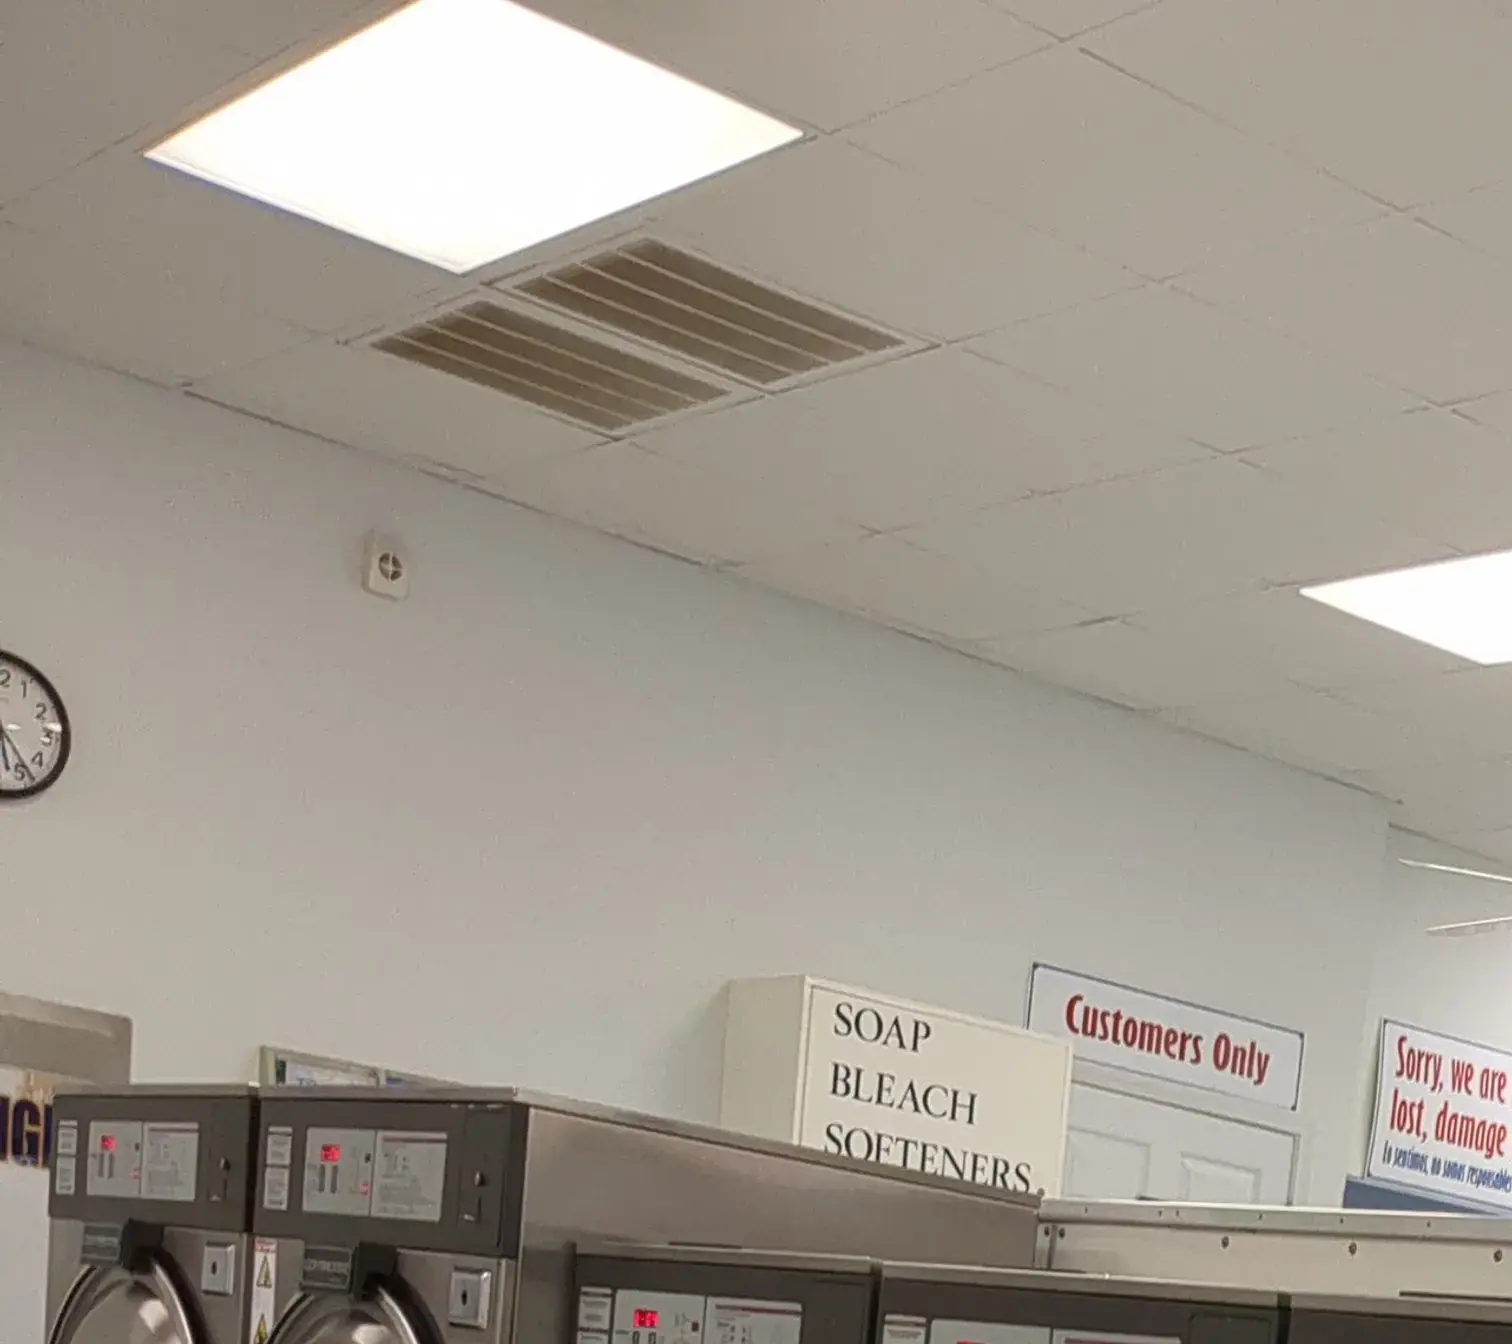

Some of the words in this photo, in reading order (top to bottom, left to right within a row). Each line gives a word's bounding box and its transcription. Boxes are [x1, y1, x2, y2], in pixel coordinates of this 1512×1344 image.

[34, 703, 47, 721] 2
[31, 751, 44, 769] 4
[833, 1001, 932, 1053] SOAP
[1066, 994, 1204, 1065] Customers
[1212, 1032, 1270, 1086] Only
[830, 1060, 978, 1125] BLEACH
[1395, 1035, 1444, 1094] Sorry,
[1451, 1058, 1474, 1095] we
[1479, 1067, 1506, 1104] are
[1390, 1087, 1428, 1144] lost,
[1435, 1101, 1508, 1160] damage
[824, 1122, 1032, 1194] SOFTENERS
